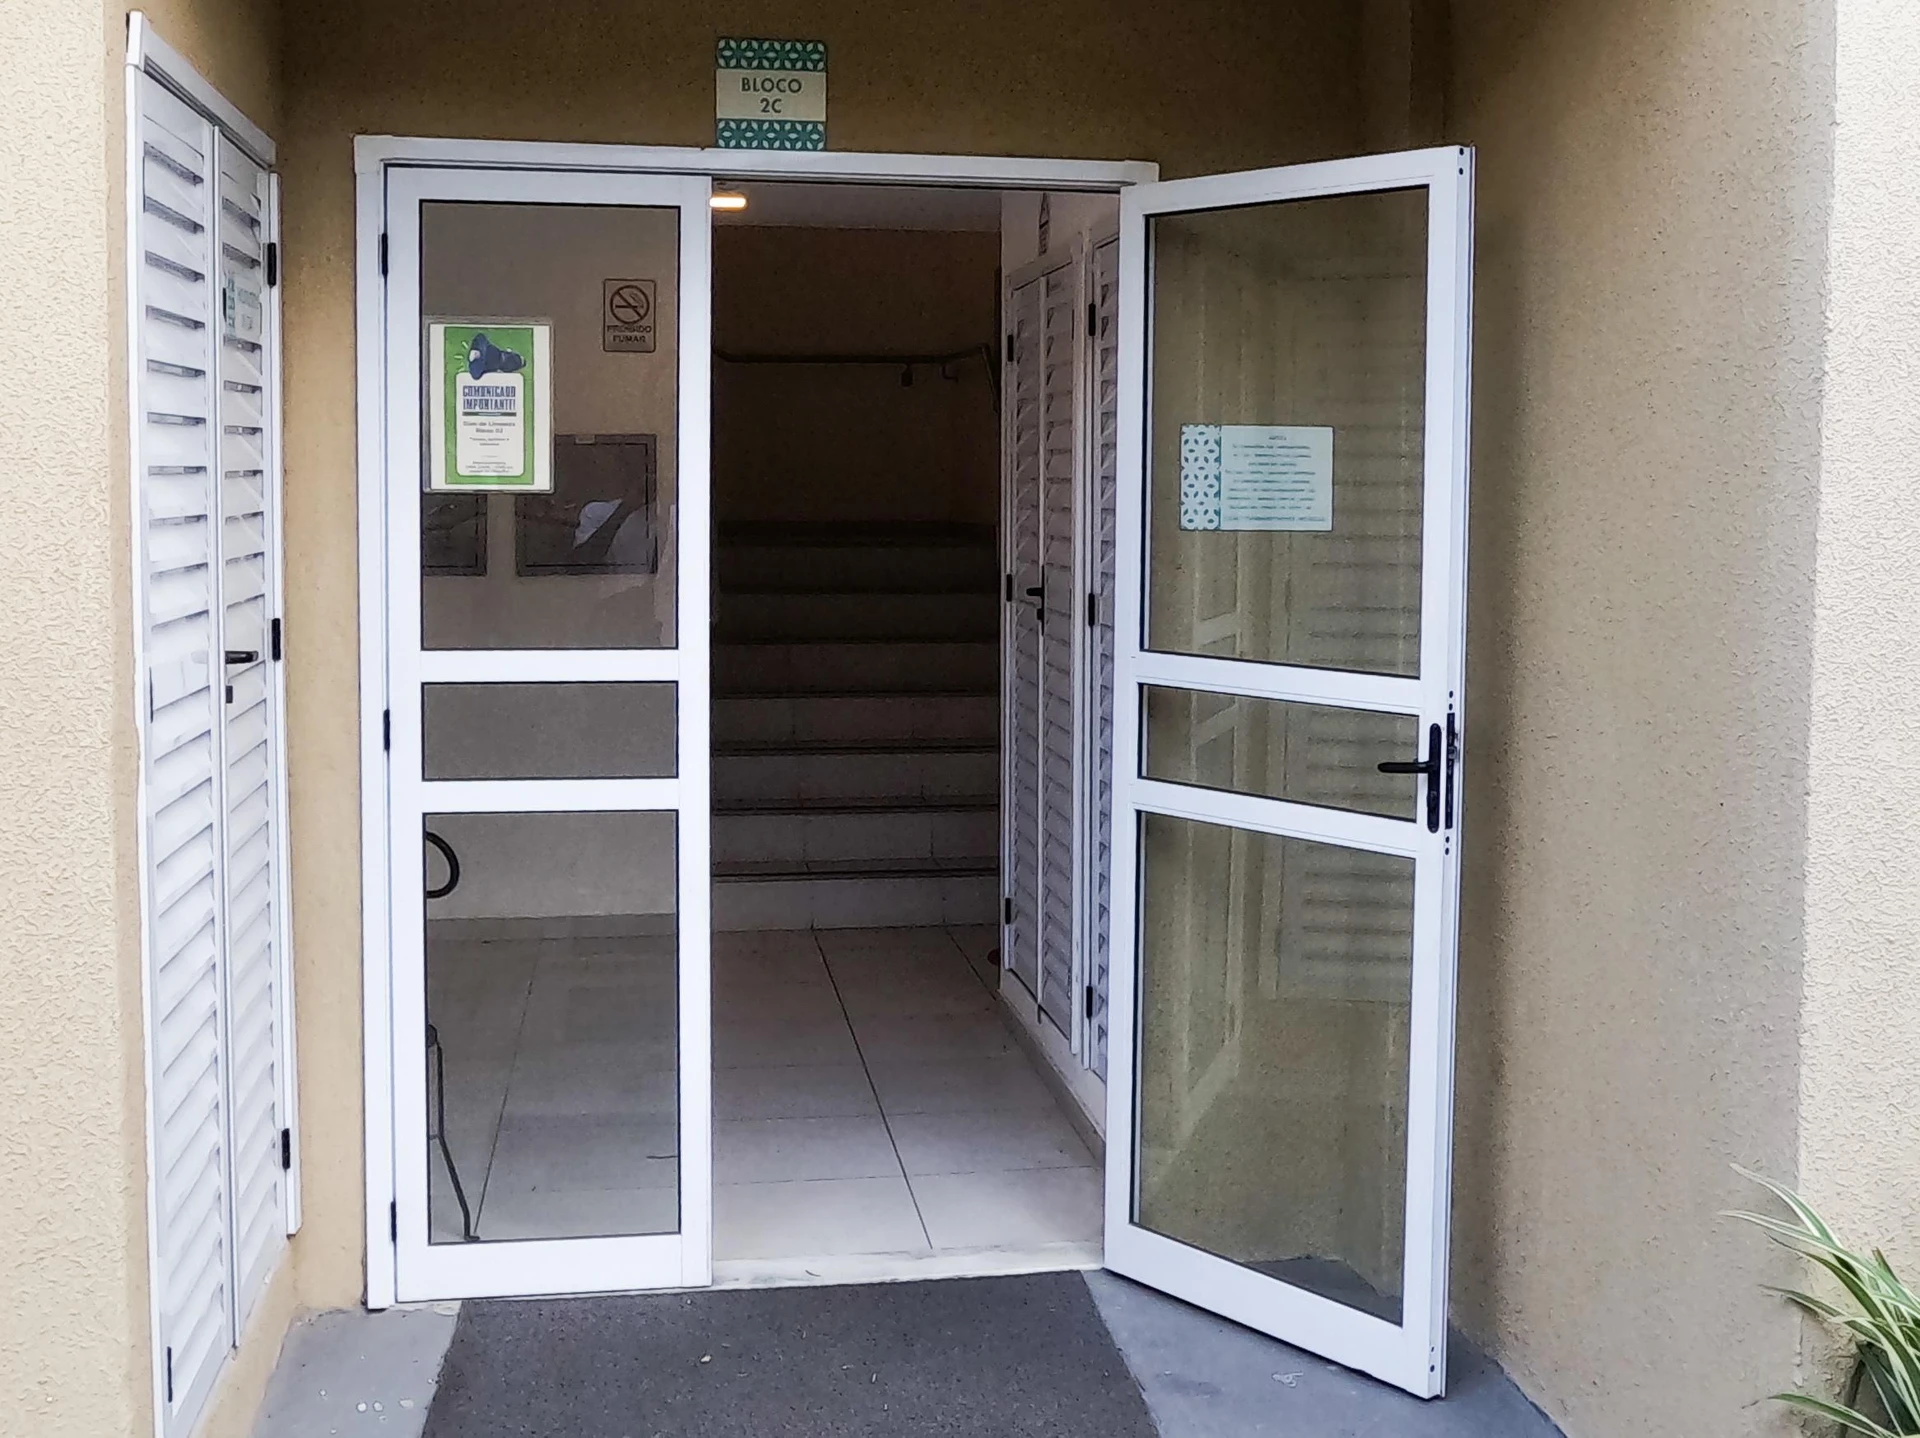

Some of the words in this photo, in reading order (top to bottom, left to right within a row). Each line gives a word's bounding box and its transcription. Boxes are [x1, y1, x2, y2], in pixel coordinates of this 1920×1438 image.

[742, 77, 802, 93] BLOCO
[760, 97, 782, 113] 2C
[462, 385, 516, 397] COMUNICADO
